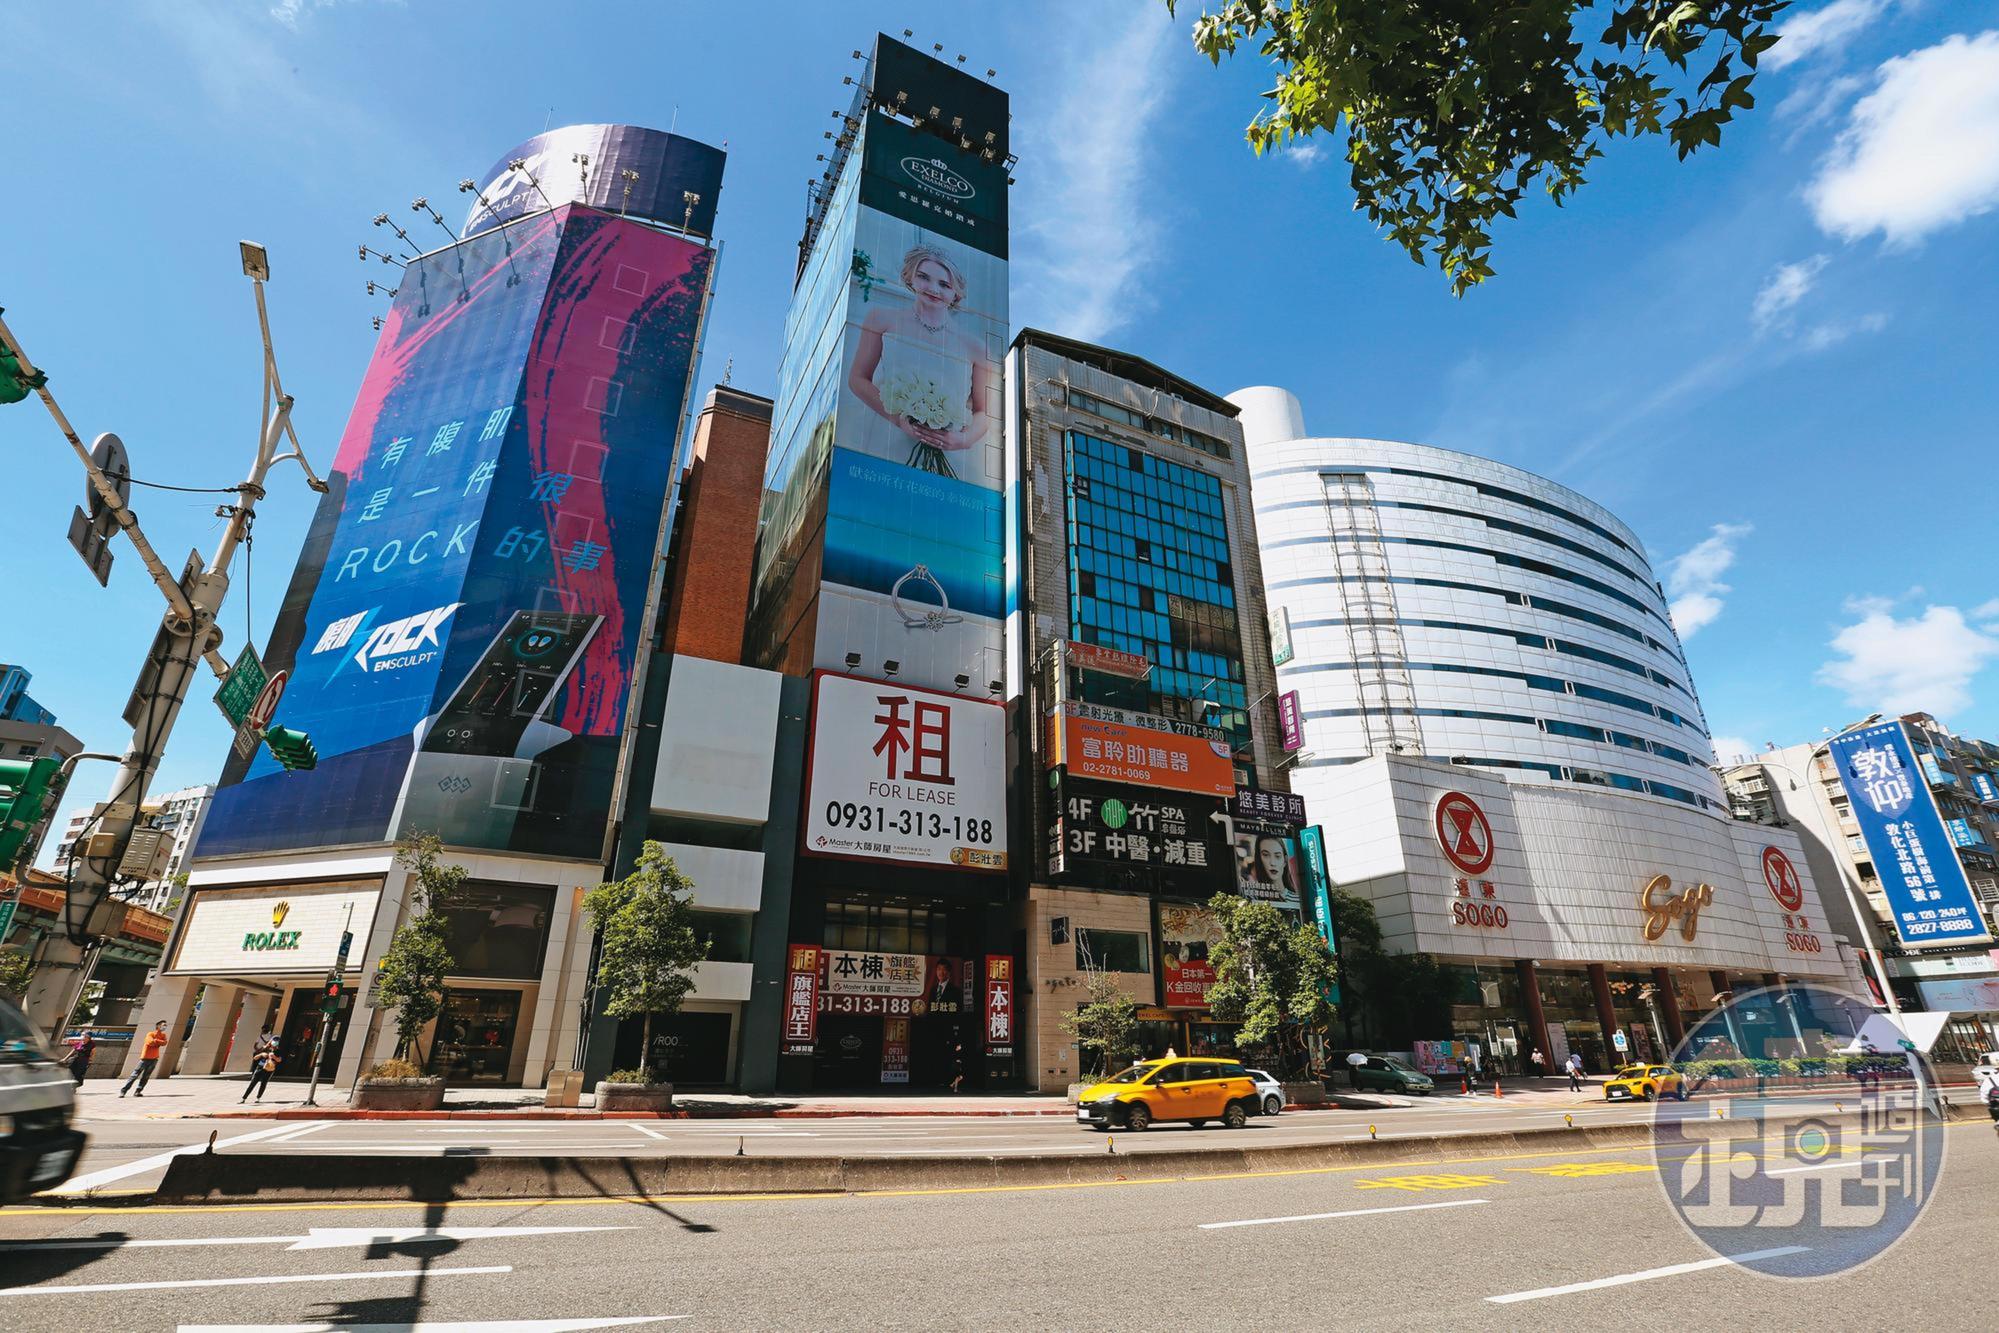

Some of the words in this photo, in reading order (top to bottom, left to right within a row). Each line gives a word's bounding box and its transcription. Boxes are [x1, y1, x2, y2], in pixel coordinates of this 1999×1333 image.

[911, 161, 968, 191] EXELCO
[357, 458, 498, 523] 是一件
[335, 520, 480, 582] ROCK
[373, 651, 438, 673] EMSCULPT
[872, 695, 956, 786] 租
[1175, 721, 1224, 741] 2778-9580
[1081, 736, 1188, 772] 富聆助聽器
[1083, 762, 1150, 780] 02-2781-0069
[869, 781, 902, 799] FOR
[907, 786, 956, 806] LEASE
[1238, 790, 1302, 815] 悠美診所
[1068, 797, 1093, 821] 4F
[1161, 806, 1185, 821] SPA
[826, 800, 992, 844] 0931-313-188
[854, 841, 892, 854] 大師房屋
[1069, 829, 1097, 854] 3F
[1450, 901, 1508, 929] SOGO
[1642, 874, 1715, 942] Sogo
[1906, 919, 1974, 935] 2827-8888
[241, 930, 302, 951] ROLEX
[1785, 931, 1822, 953] SOGO
[791, 949, 817, 970] 租
[834, 952, 884, 980] 本棟
[989, 959, 1010, 980] 租
[1181, 968, 1213, 979] 日本第一
[817, 995, 911, 1014] 31-313-188
[990, 985, 1010, 1039] 本棟
